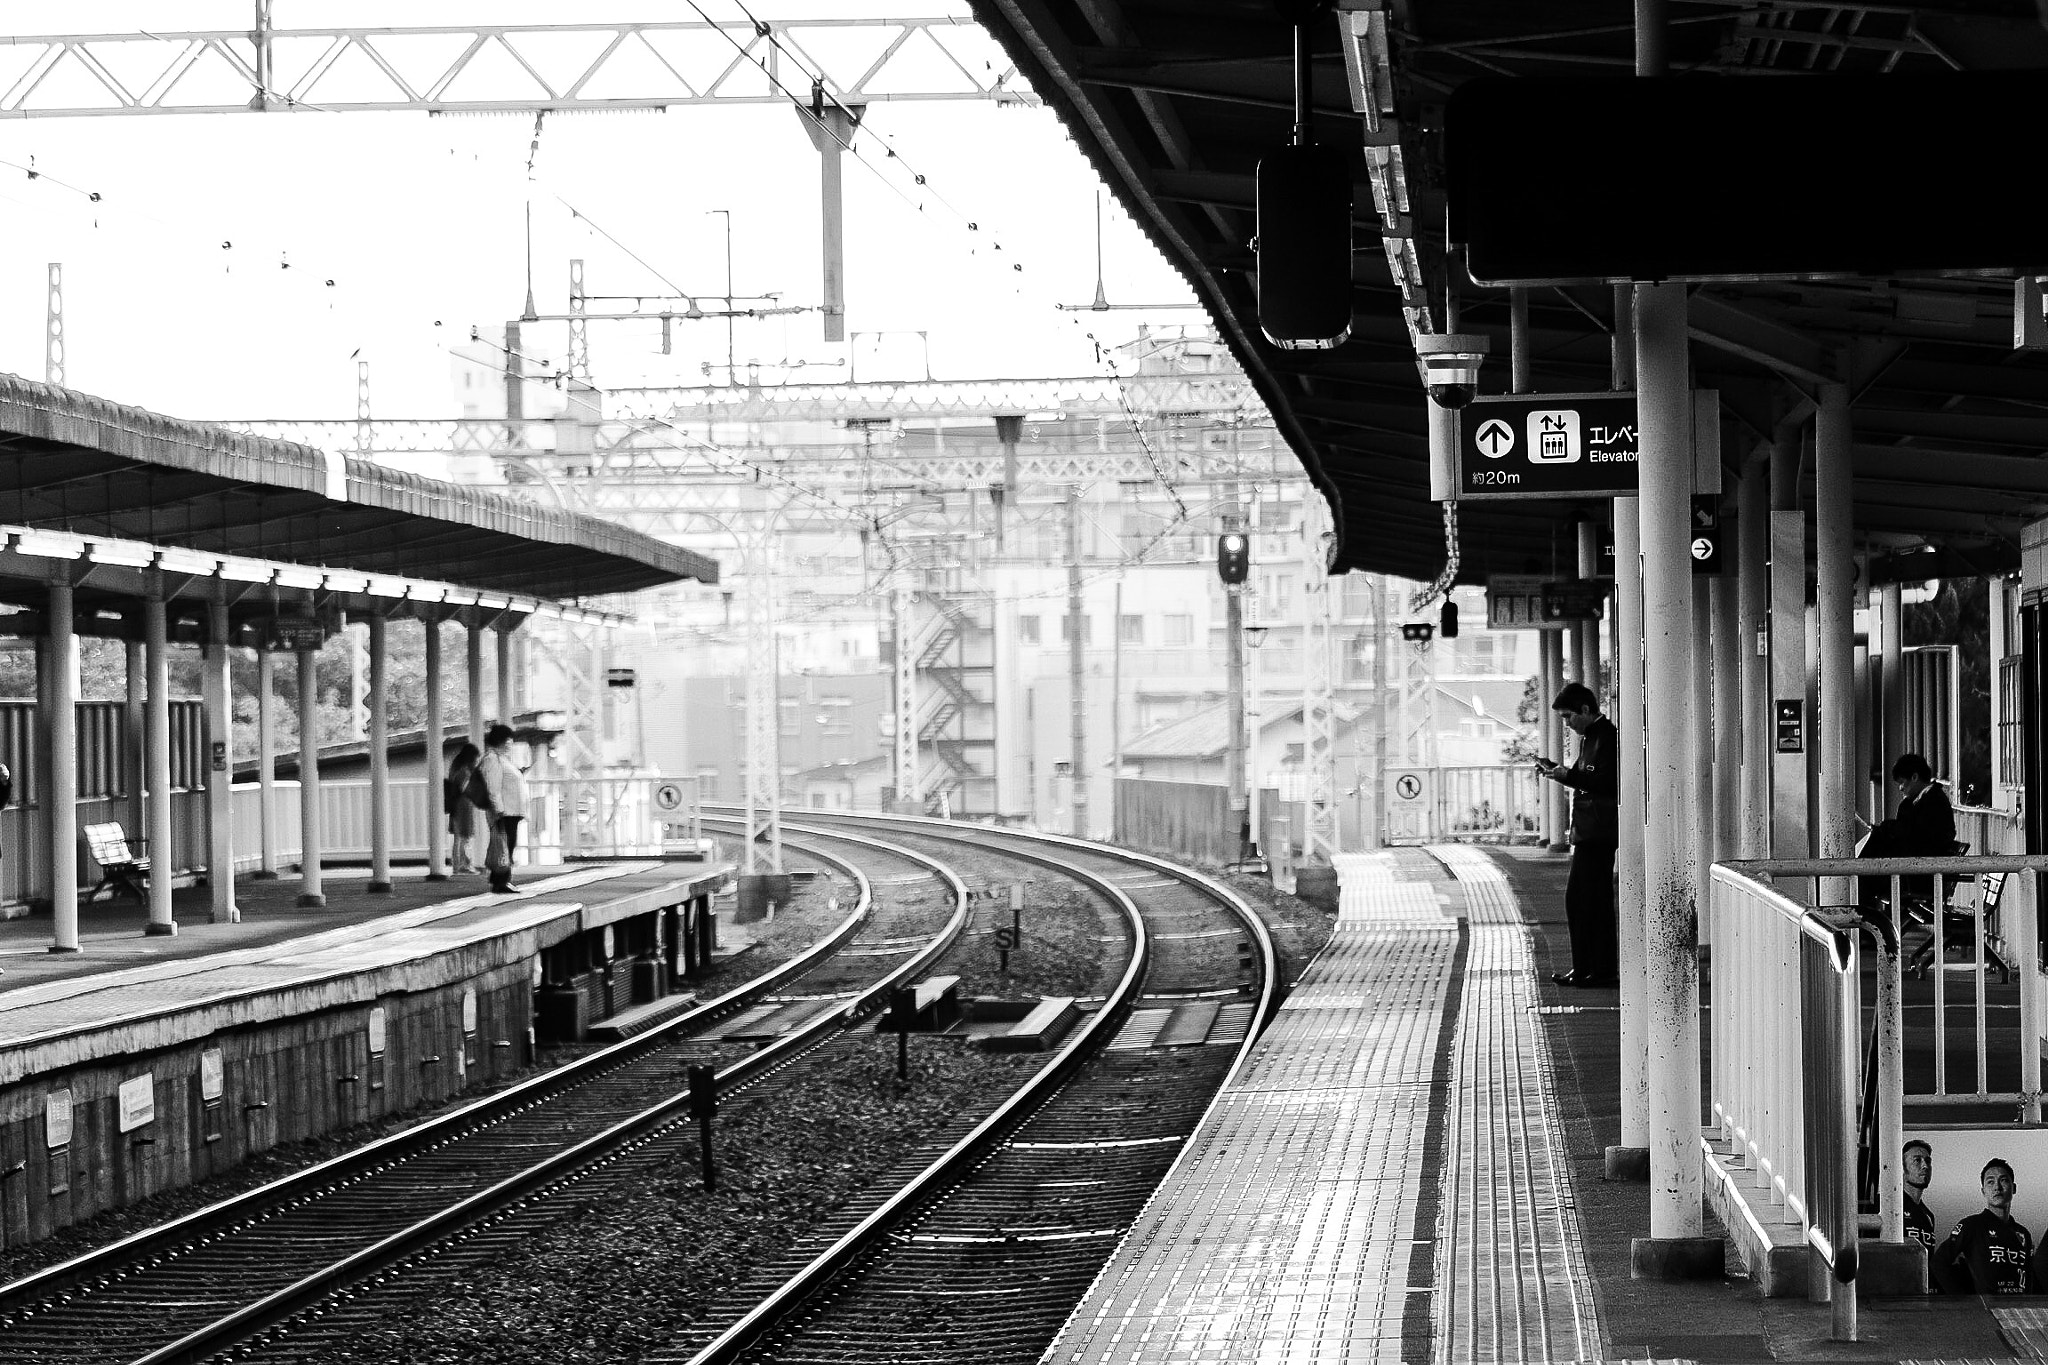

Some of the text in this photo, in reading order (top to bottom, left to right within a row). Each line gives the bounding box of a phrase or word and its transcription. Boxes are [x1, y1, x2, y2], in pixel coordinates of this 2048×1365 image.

[1590, 425, 1639, 445] エレベ
[1590, 450, 1639, 463] Elevator
[1472, 470, 1520, 485] 約20m
[996, 928, 1012, 949] S
